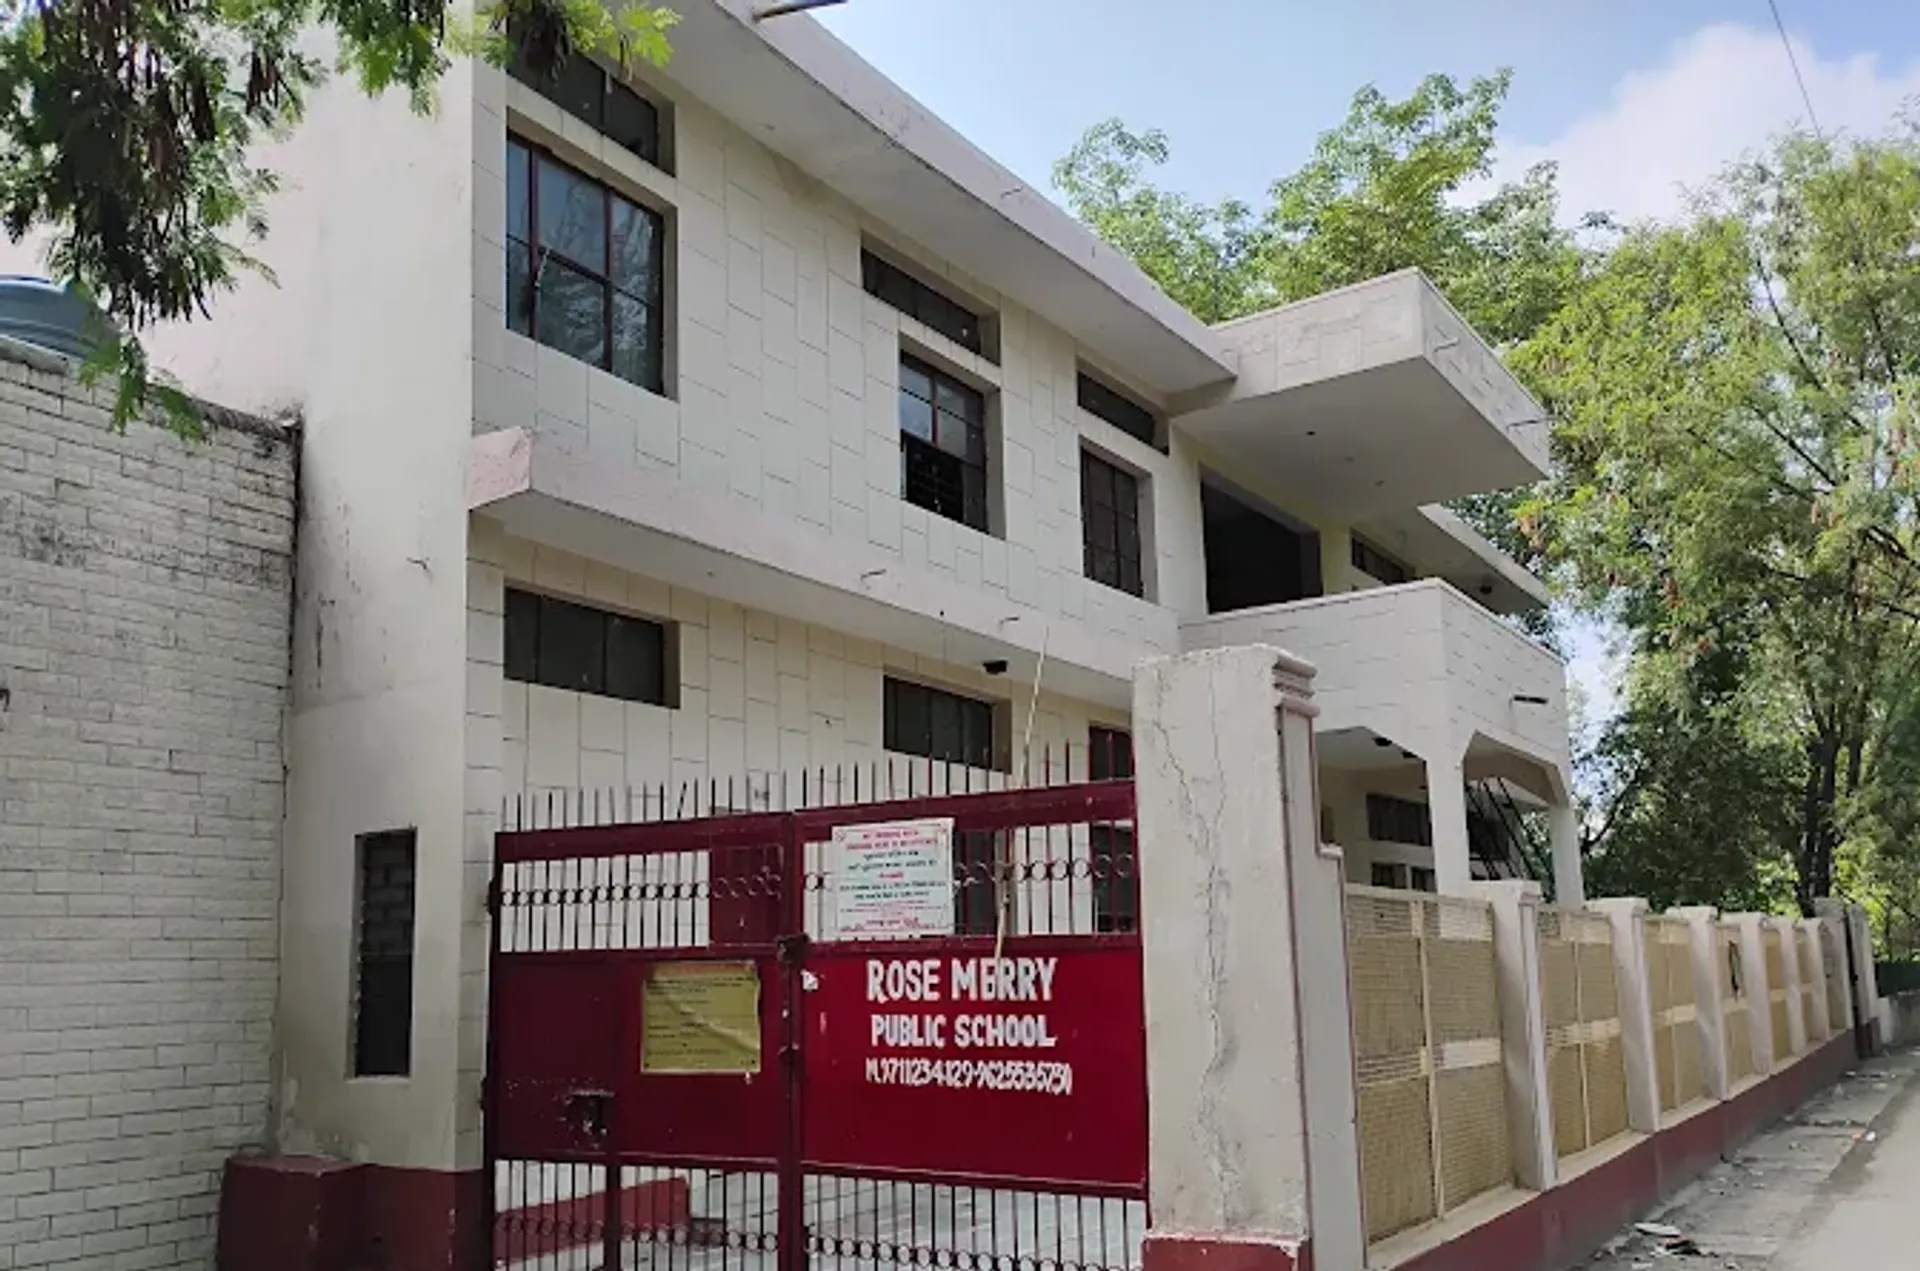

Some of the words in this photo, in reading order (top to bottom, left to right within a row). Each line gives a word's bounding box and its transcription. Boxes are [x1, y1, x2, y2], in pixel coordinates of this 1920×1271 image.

[864, 958, 942, 1003] ROSE
[951, 955, 1058, 1001] MERRY
[871, 1014, 946, 1048] PUBLIC
[955, 1015, 1057, 1047] SCHOOL
